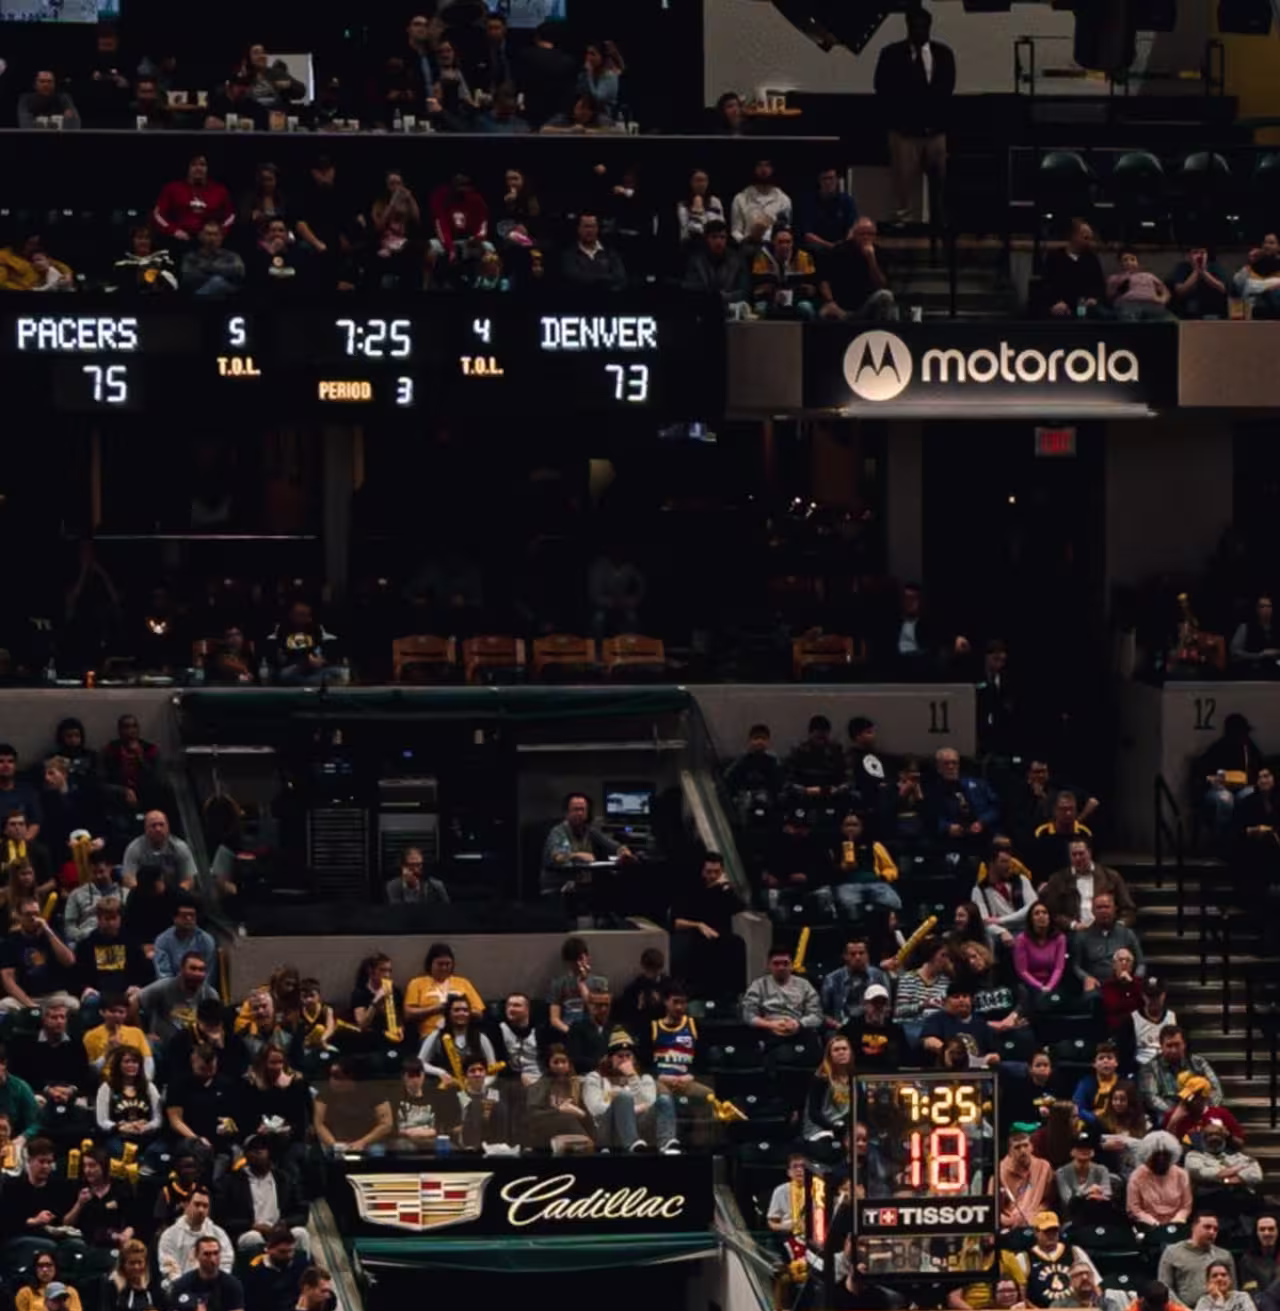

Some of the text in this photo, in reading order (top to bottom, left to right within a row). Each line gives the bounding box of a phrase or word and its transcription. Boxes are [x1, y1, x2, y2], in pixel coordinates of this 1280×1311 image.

[17, 317, 137, 349] PACERS
[336, 320, 411, 357] 7:25
[473, 319, 491, 343] 4
[540, 317, 657, 349] DENVER
[921, 341, 1139, 382] motorola
[83, 366, 127, 402] 75
[319, 378, 413, 403] PERIOD 3
[605, 365, 648, 401] 73
[928, 702, 950, 734] 11
[1194, 698, 1215, 731] 12
[900, 1086, 976, 1124] 7:25
[911, 1127, 967, 1191] 18
[500, 1174, 685, 1226] Cadillac
[899, 1206, 989, 1225] TISSOT
